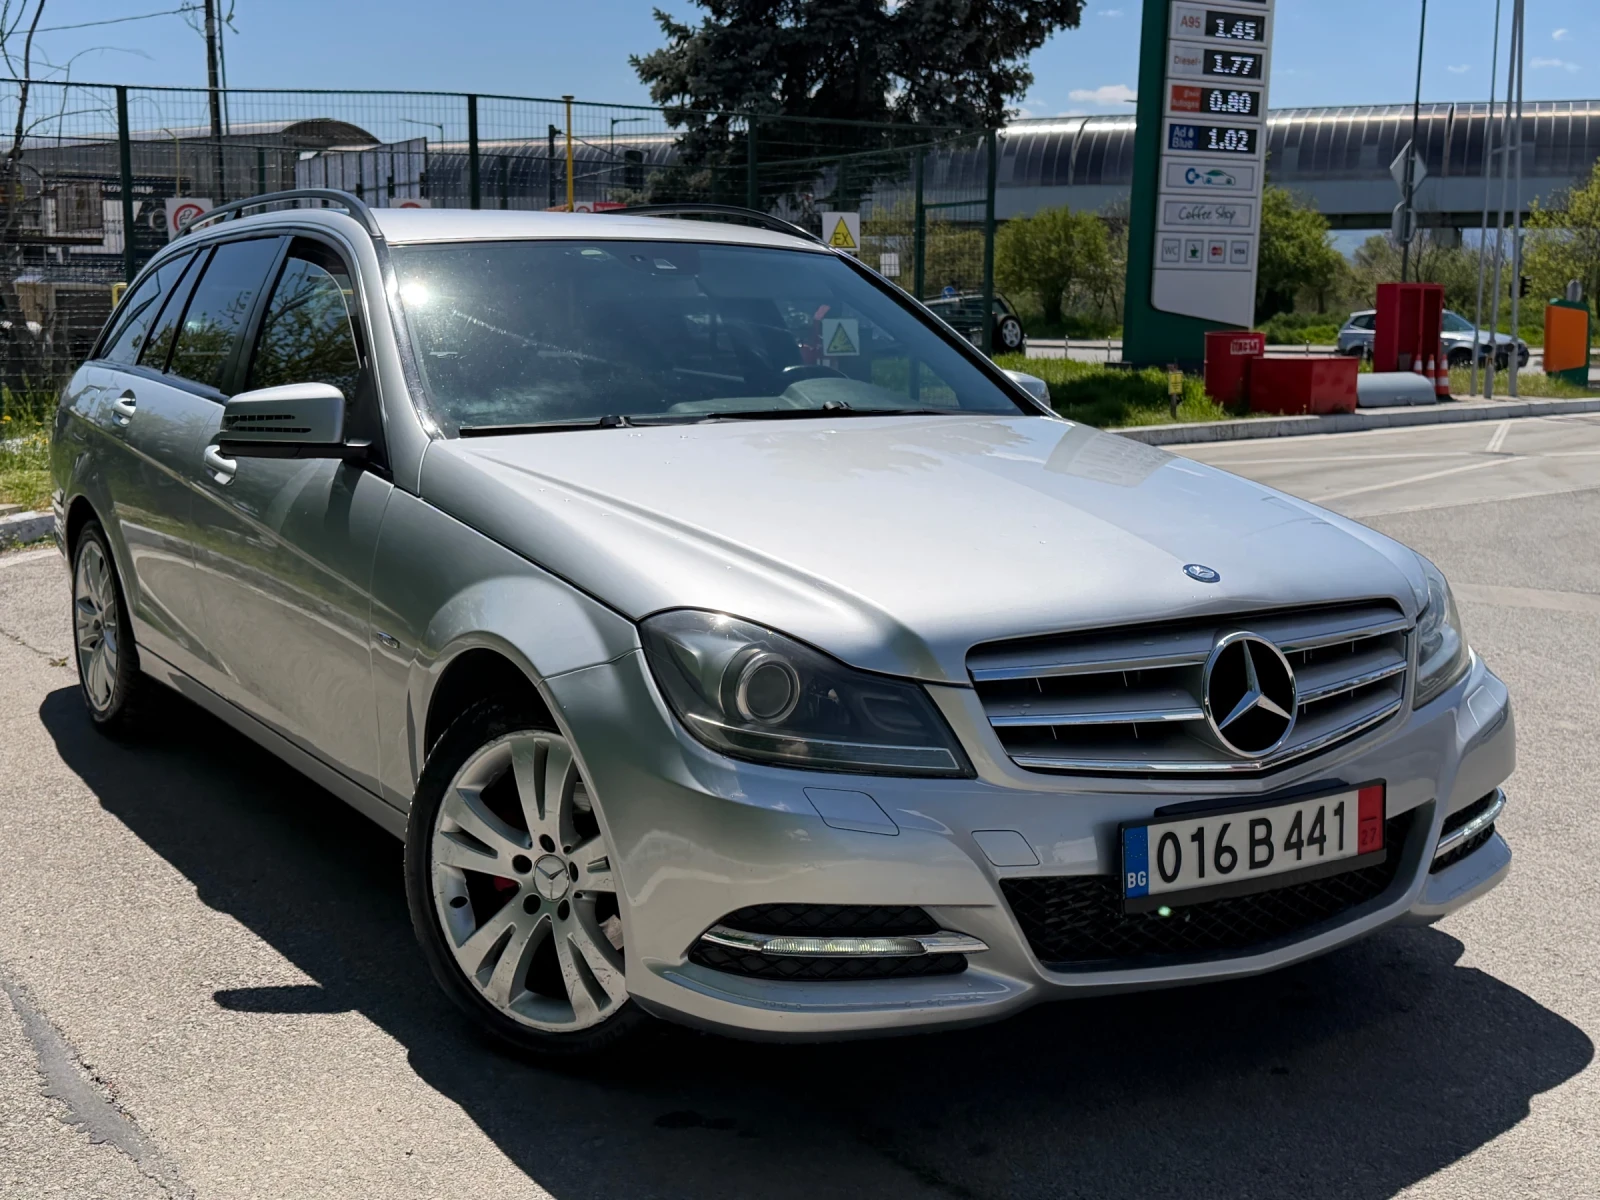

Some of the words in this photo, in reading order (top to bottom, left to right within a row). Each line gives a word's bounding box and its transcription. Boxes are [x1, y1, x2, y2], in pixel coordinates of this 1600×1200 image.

[1181, 15, 1201, 29] A95
[1215, 18, 1256, 40] 1.45
[1213, 54, 1254, 75] 1.77
[1171, 137, 1194, 149] Blue
[1173, 126, 1187, 138] Ad
[1208, 128, 1249, 151] 1.02
[1178, 205, 1212, 221] Coffee
[1215, 205, 1236, 225] Shop
[834, 232, 850, 246] EX
[1164, 246, 1178, 256] WC
[1361, 828, 1377, 846] 27
[1127, 871, 1146, 888] BG
